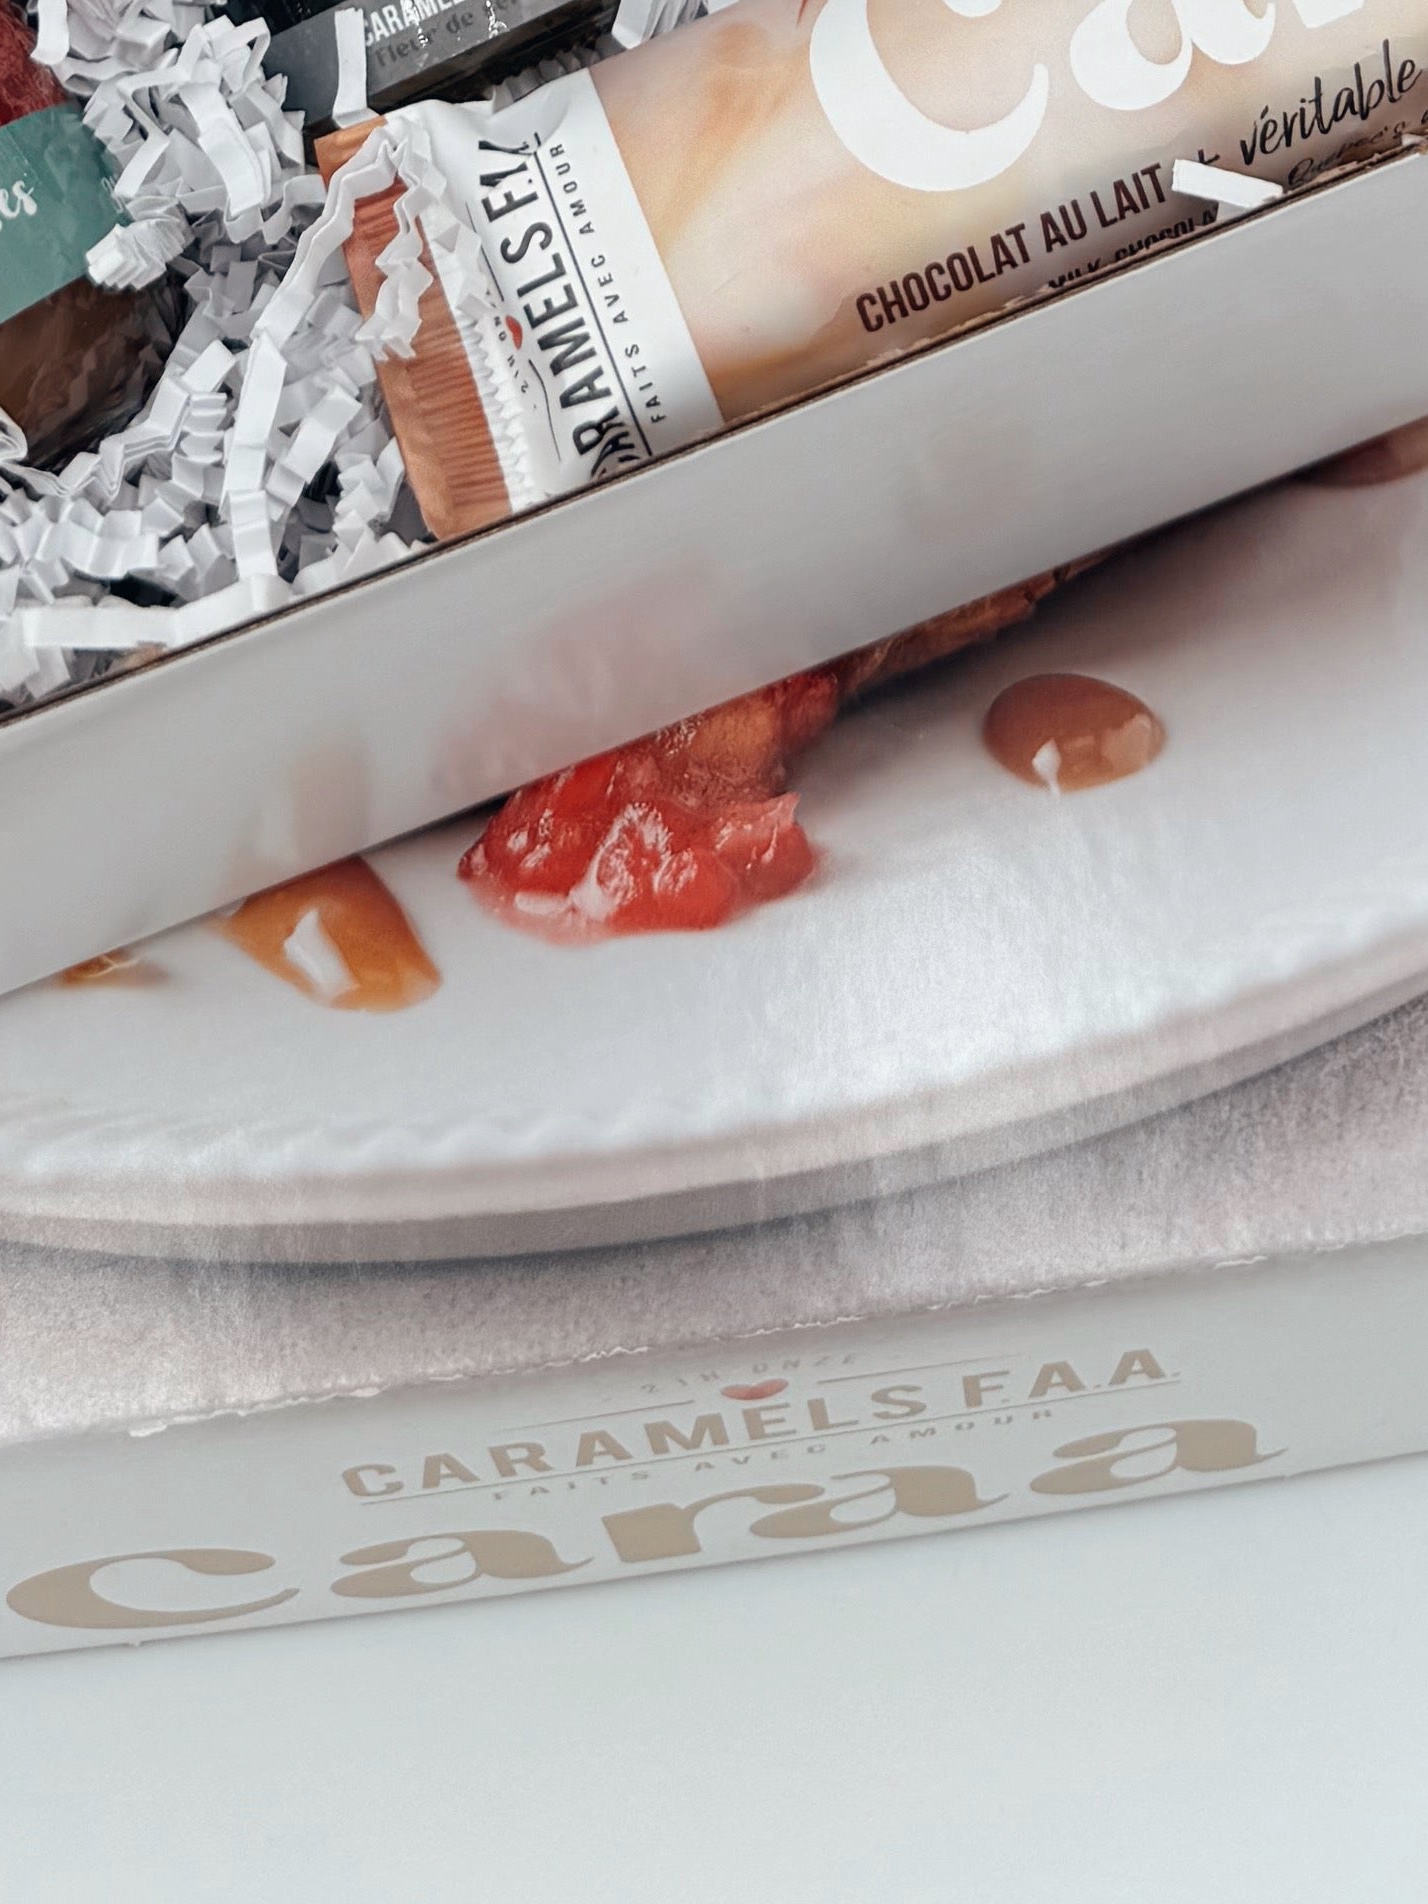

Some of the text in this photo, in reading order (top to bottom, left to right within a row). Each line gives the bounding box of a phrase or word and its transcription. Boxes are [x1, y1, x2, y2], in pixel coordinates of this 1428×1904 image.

[1239, 38, 1423, 167] véritable
[549, 143, 667, 425] FAITS AVEC AMOUR
[855, 222, 1032, 333] CHOCOLAT
[1042, 198, 1089, 254] AU
[1091, 161, 1168, 229] LAIT
[341, 1384, 928, 1498] CARAMELS
